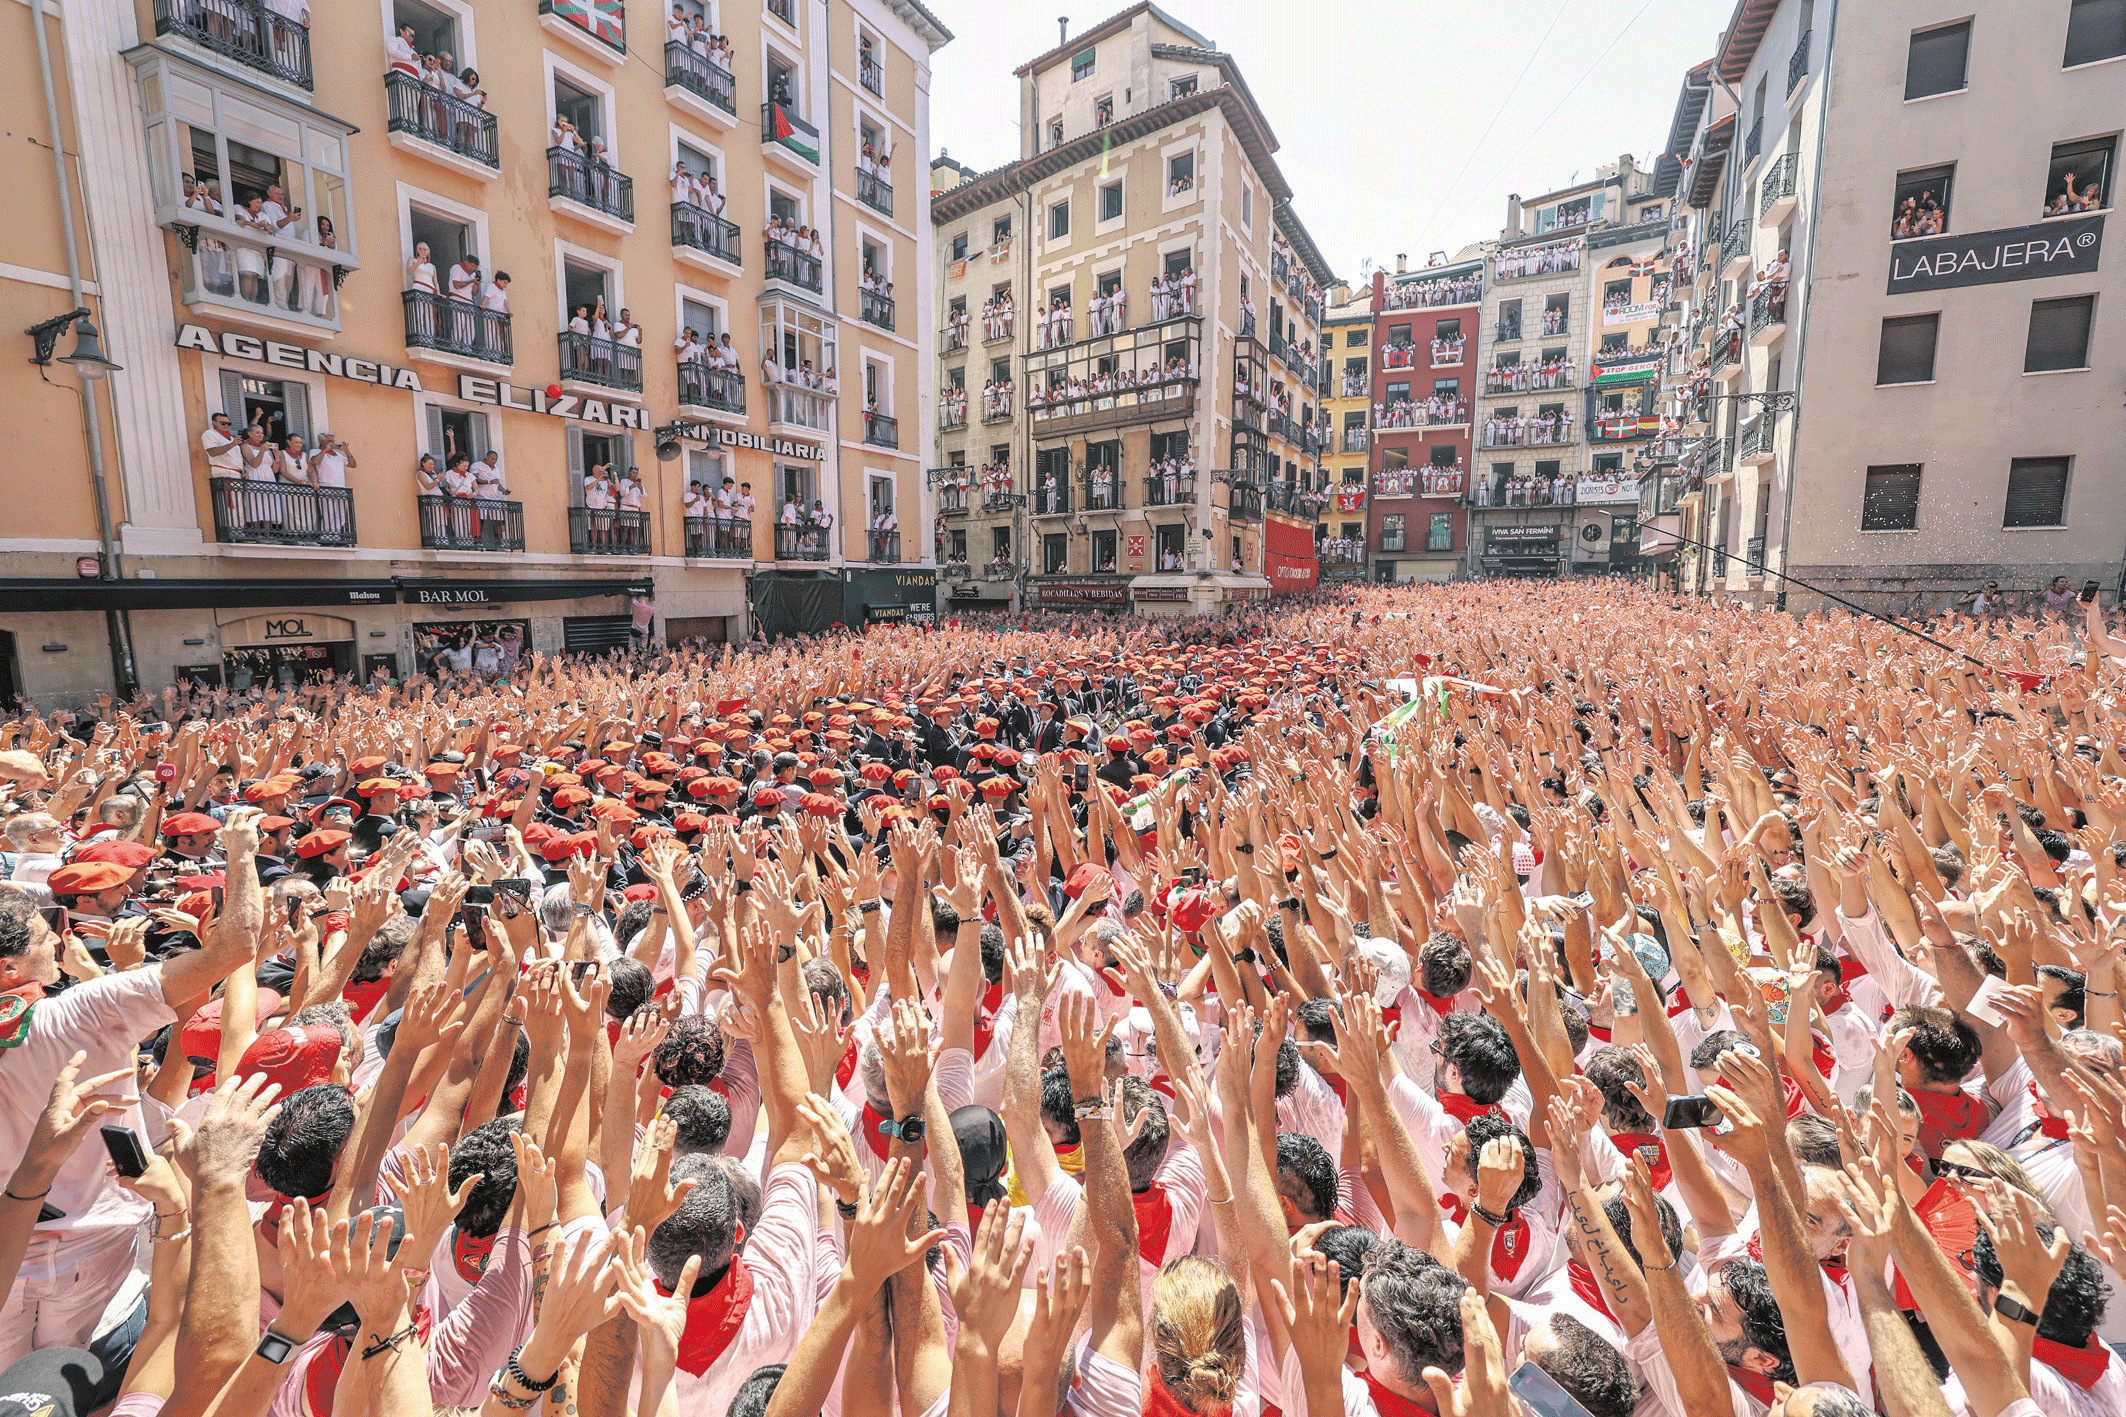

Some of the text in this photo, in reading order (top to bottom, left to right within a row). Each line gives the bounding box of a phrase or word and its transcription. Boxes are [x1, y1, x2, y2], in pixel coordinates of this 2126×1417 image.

[1619, 304, 1644, 315] ROOM
[175, 323, 423, 392] AGENCIA
[458, 374, 650, 430] ELIZARI
[1580, 486, 1604, 494] ZIONISTS
[1621, 485, 1634, 493] NOT
[896, 575, 935, 586] VIANDAS
[349, 591, 381, 599] Mahou
[419, 590, 489, 603] BAR MOL
[1042, 589, 1082, 597] BOCADILLOS
[1091, 590, 1123, 598] BEBIDAS
[910, 603, 931, 611] WE'RE
[874, 608, 904, 618] VIANDAS
[265, 619, 312, 637] MOL
